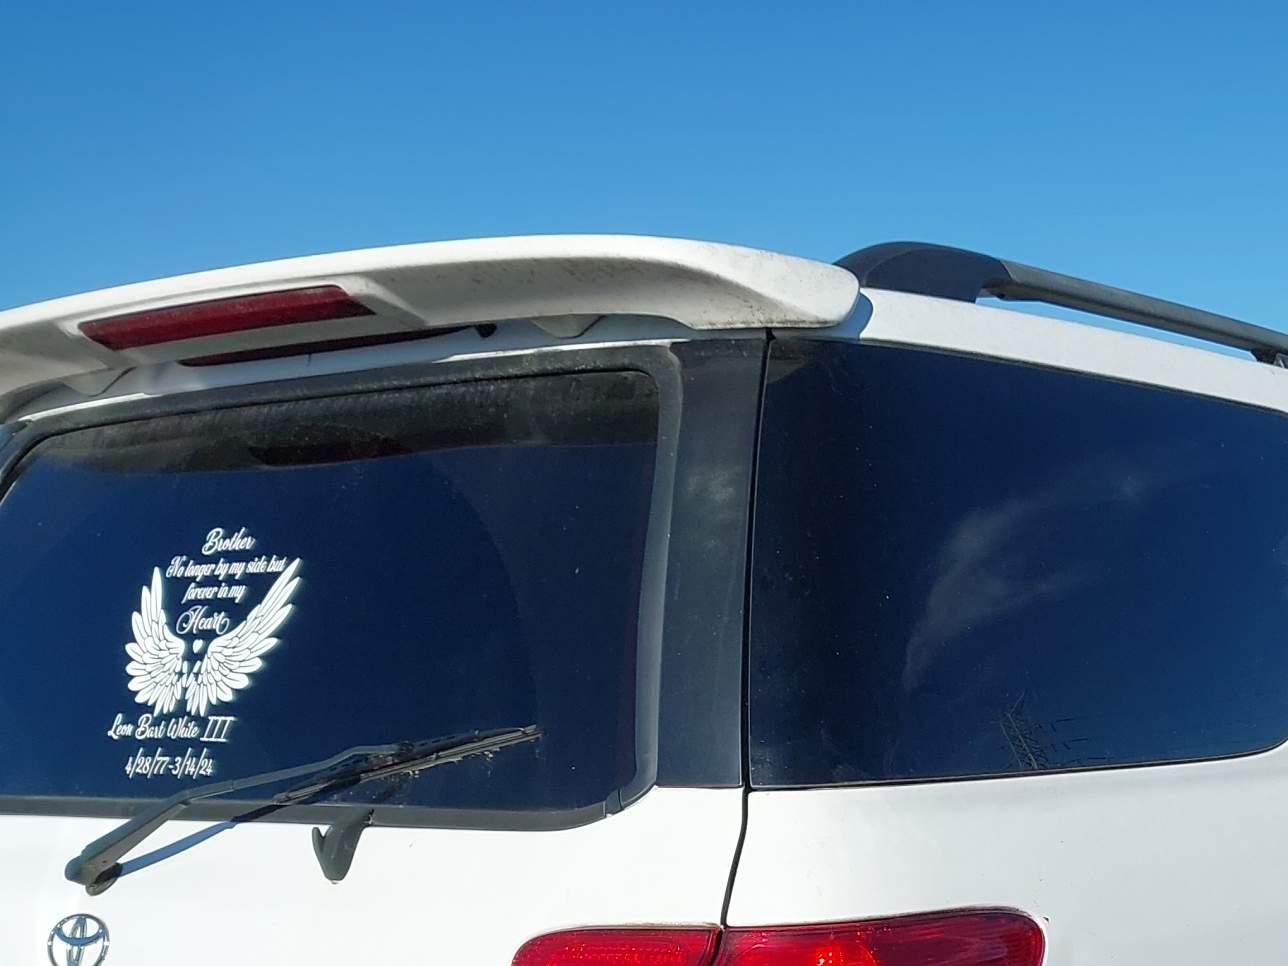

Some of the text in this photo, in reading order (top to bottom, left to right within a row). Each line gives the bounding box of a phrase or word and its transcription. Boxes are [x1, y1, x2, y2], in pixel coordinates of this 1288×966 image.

[201, 527, 255, 555] Brother
[166, 555, 287, 581] No longer by my side but
[181, 583, 245, 604] forever in my
[176, 605, 230, 634] Heart
[107, 713, 235, 742] Leon Bart White III
[125, 747, 214, 779] 4/28/77-3/14/24
